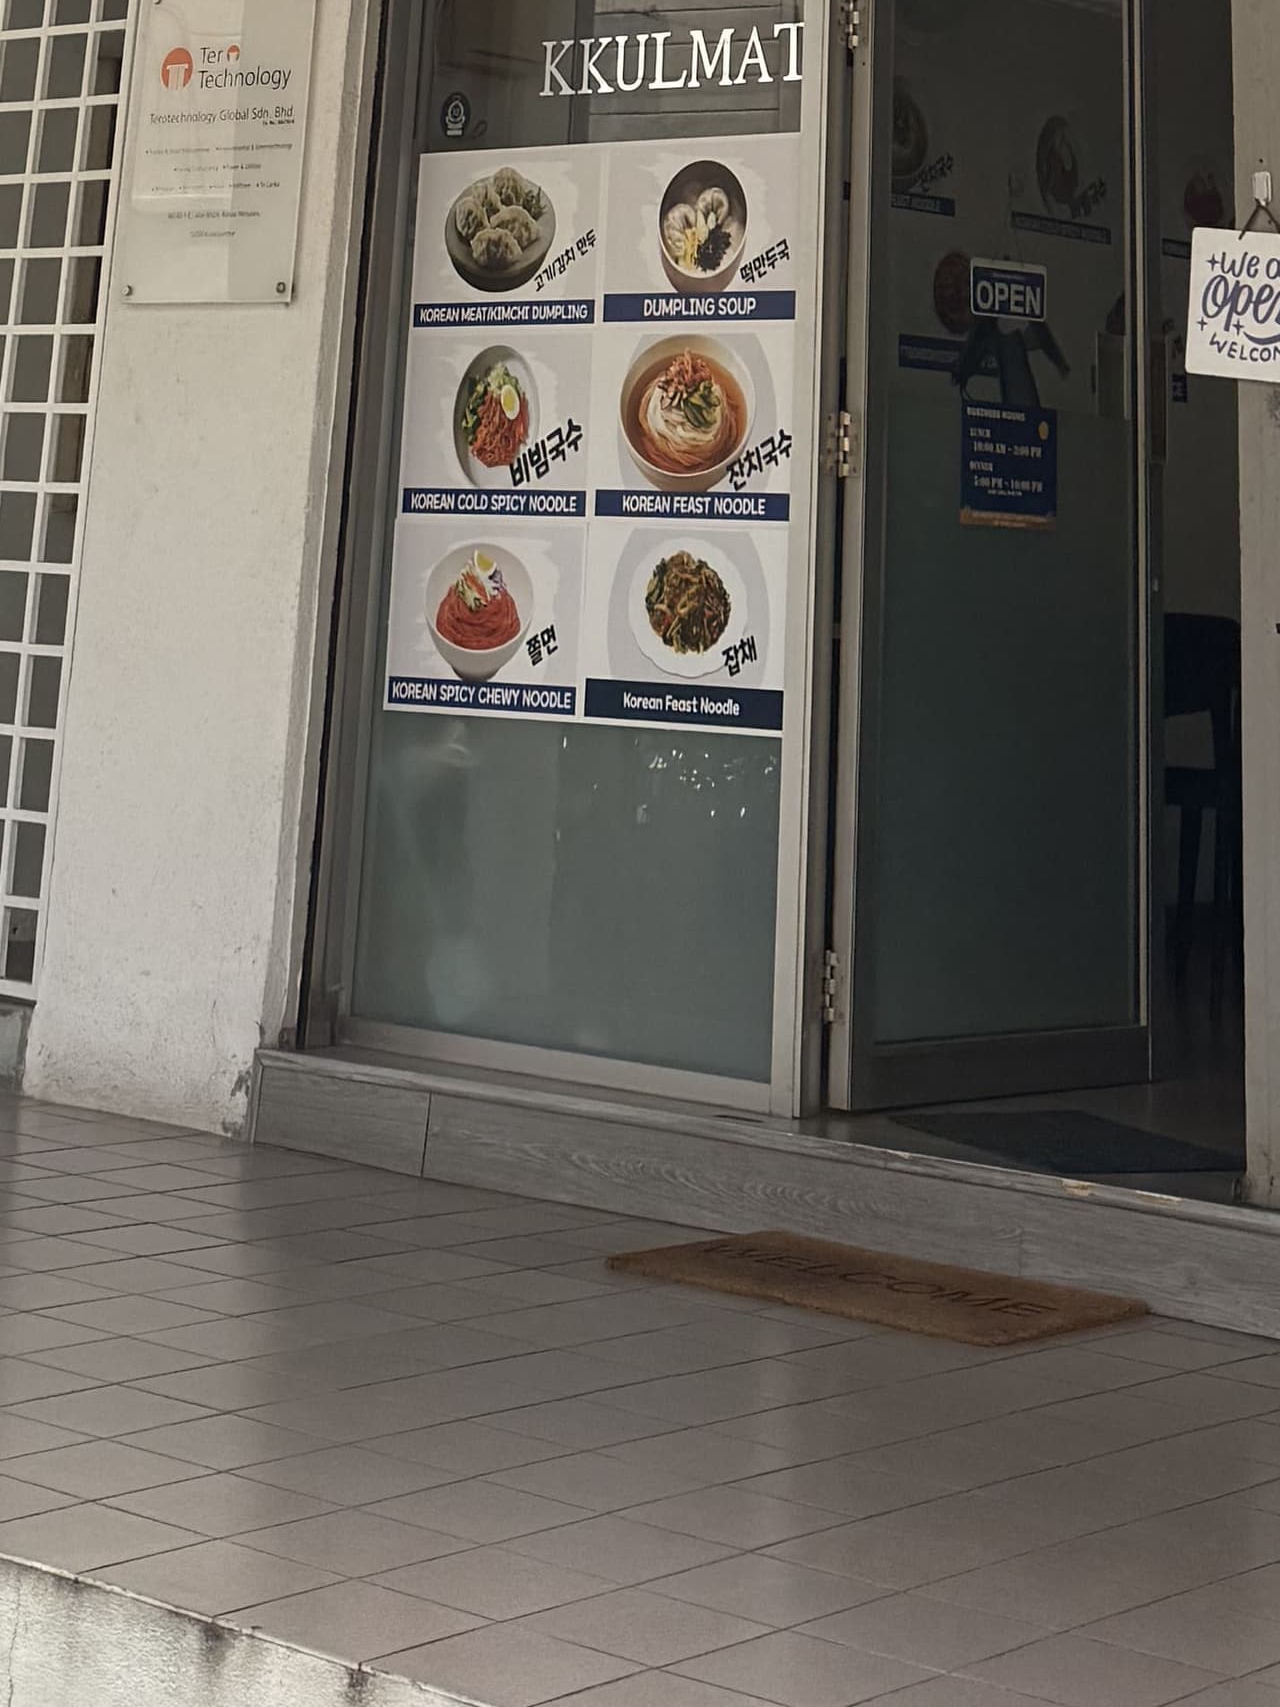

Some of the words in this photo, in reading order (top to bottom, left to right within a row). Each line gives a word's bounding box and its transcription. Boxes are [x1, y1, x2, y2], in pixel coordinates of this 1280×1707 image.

[539, 22, 804, 97] KKULMAT
[198, 67, 292, 91] Technology
[740, 240, 789, 283] 떡만두국
[642, 298, 714, 317] DUMPLING
[717, 297, 757, 315] SOUP
[976, 281, 1041, 315] OPEN
[419, 307, 460, 324] KOREAN
[461, 305, 529, 323] MEAT/KIMCHI
[530, 303, 588, 321] DUMPLING
[510, 419, 582, 488] 비빔국수
[726, 430, 793, 492] 잔치국수
[410, 494, 453, 511] KOREAN
[457, 494, 489, 512] COLD
[491, 494, 526, 512] SPICY
[530, 495, 577, 513] NOODLE
[622, 495, 669, 513] KOREAN
[672, 496, 711, 514] FEAST
[715, 497, 766, 515] NOODLE
[526, 626, 558, 666] 쫄면
[722, 638, 757, 677] 잡채
[392, 683, 436, 701] KOREAN
[440, 685, 475, 703] SPICY
[478, 686, 519, 706] CHEWY
[522, 689, 572, 709] NOODLE
[623, 694, 661, 710] Korean
[664, 696, 696, 712] Feast
[700, 698, 740, 716] Noodle
